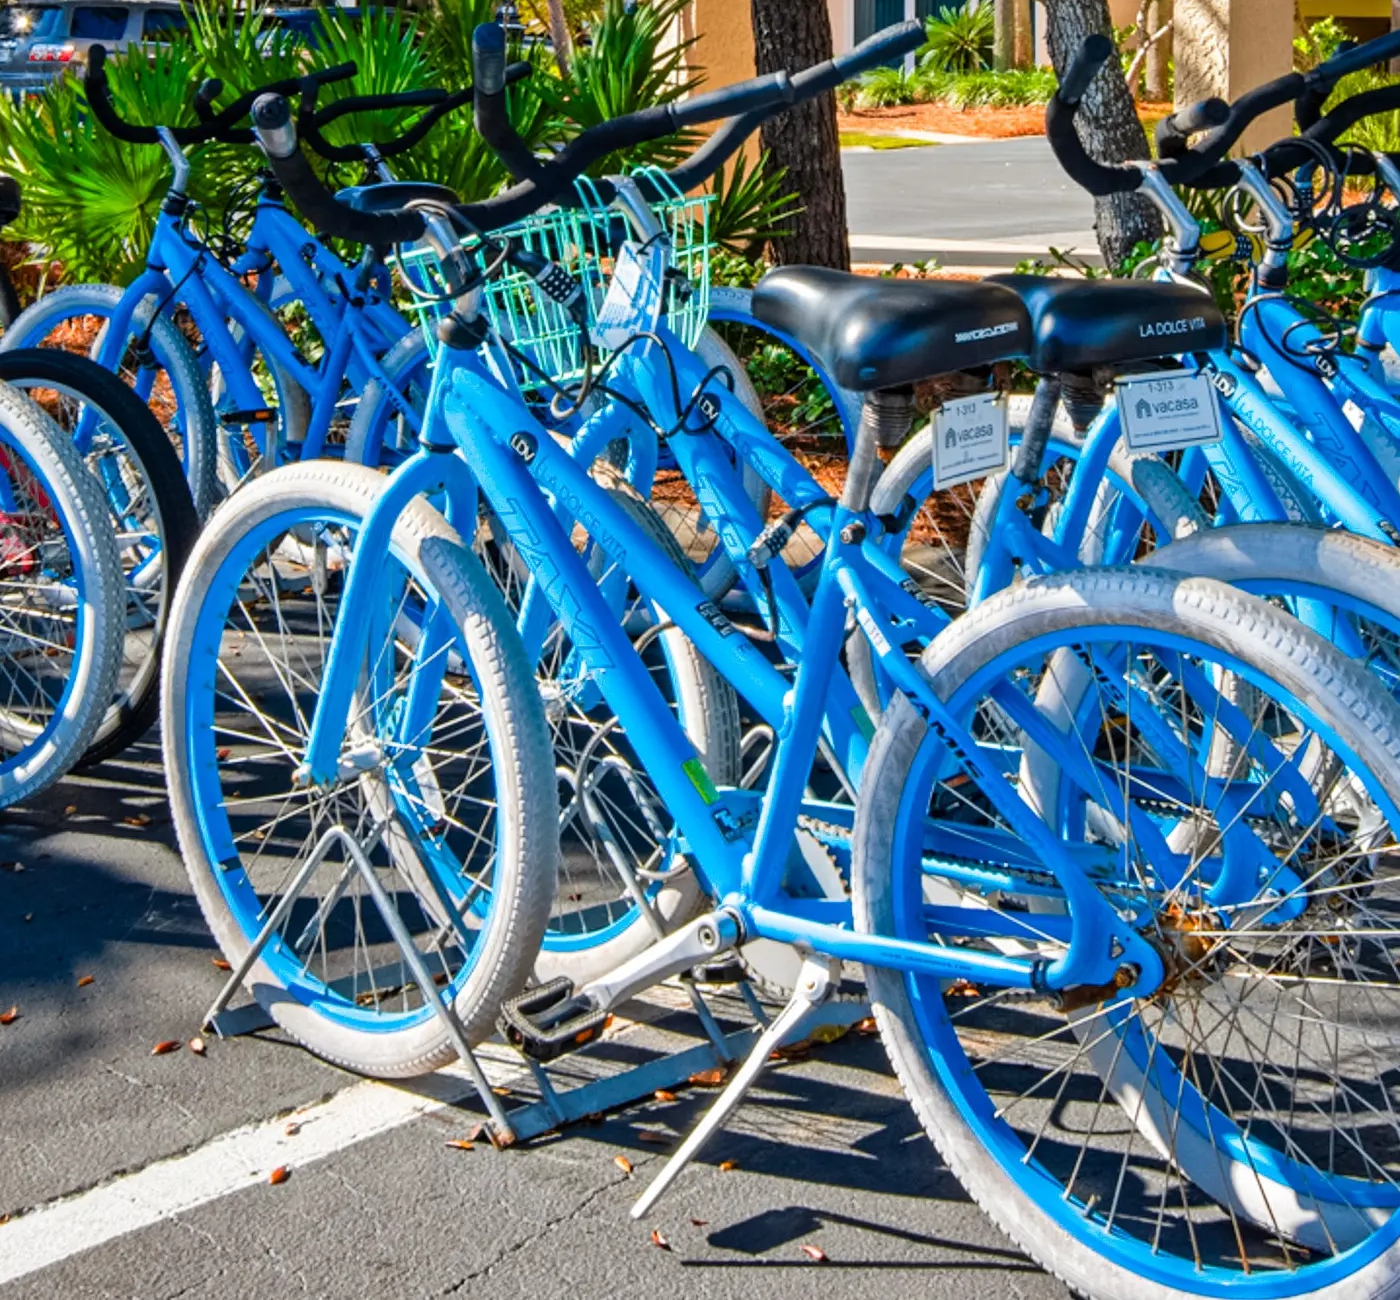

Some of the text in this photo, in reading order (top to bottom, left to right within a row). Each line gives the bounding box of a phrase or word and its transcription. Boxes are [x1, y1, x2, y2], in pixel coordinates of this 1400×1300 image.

[1139, 317, 1206, 338] LA DOLCE VITA
[1315, 354, 1336, 377] LDV
[1147, 380, 1175, 393] 1-313
[1152, 397, 1199, 414] vacasa
[956, 423, 994, 443] vacasa
[1237, 401, 1316, 485] LA DOLCE VITA
[510, 434, 535, 462] LDV
[539, 464, 627, 561] LA DOLCE VITA
[496, 496, 616, 670] TAXI
[904, 690, 986, 779] JAMIS
